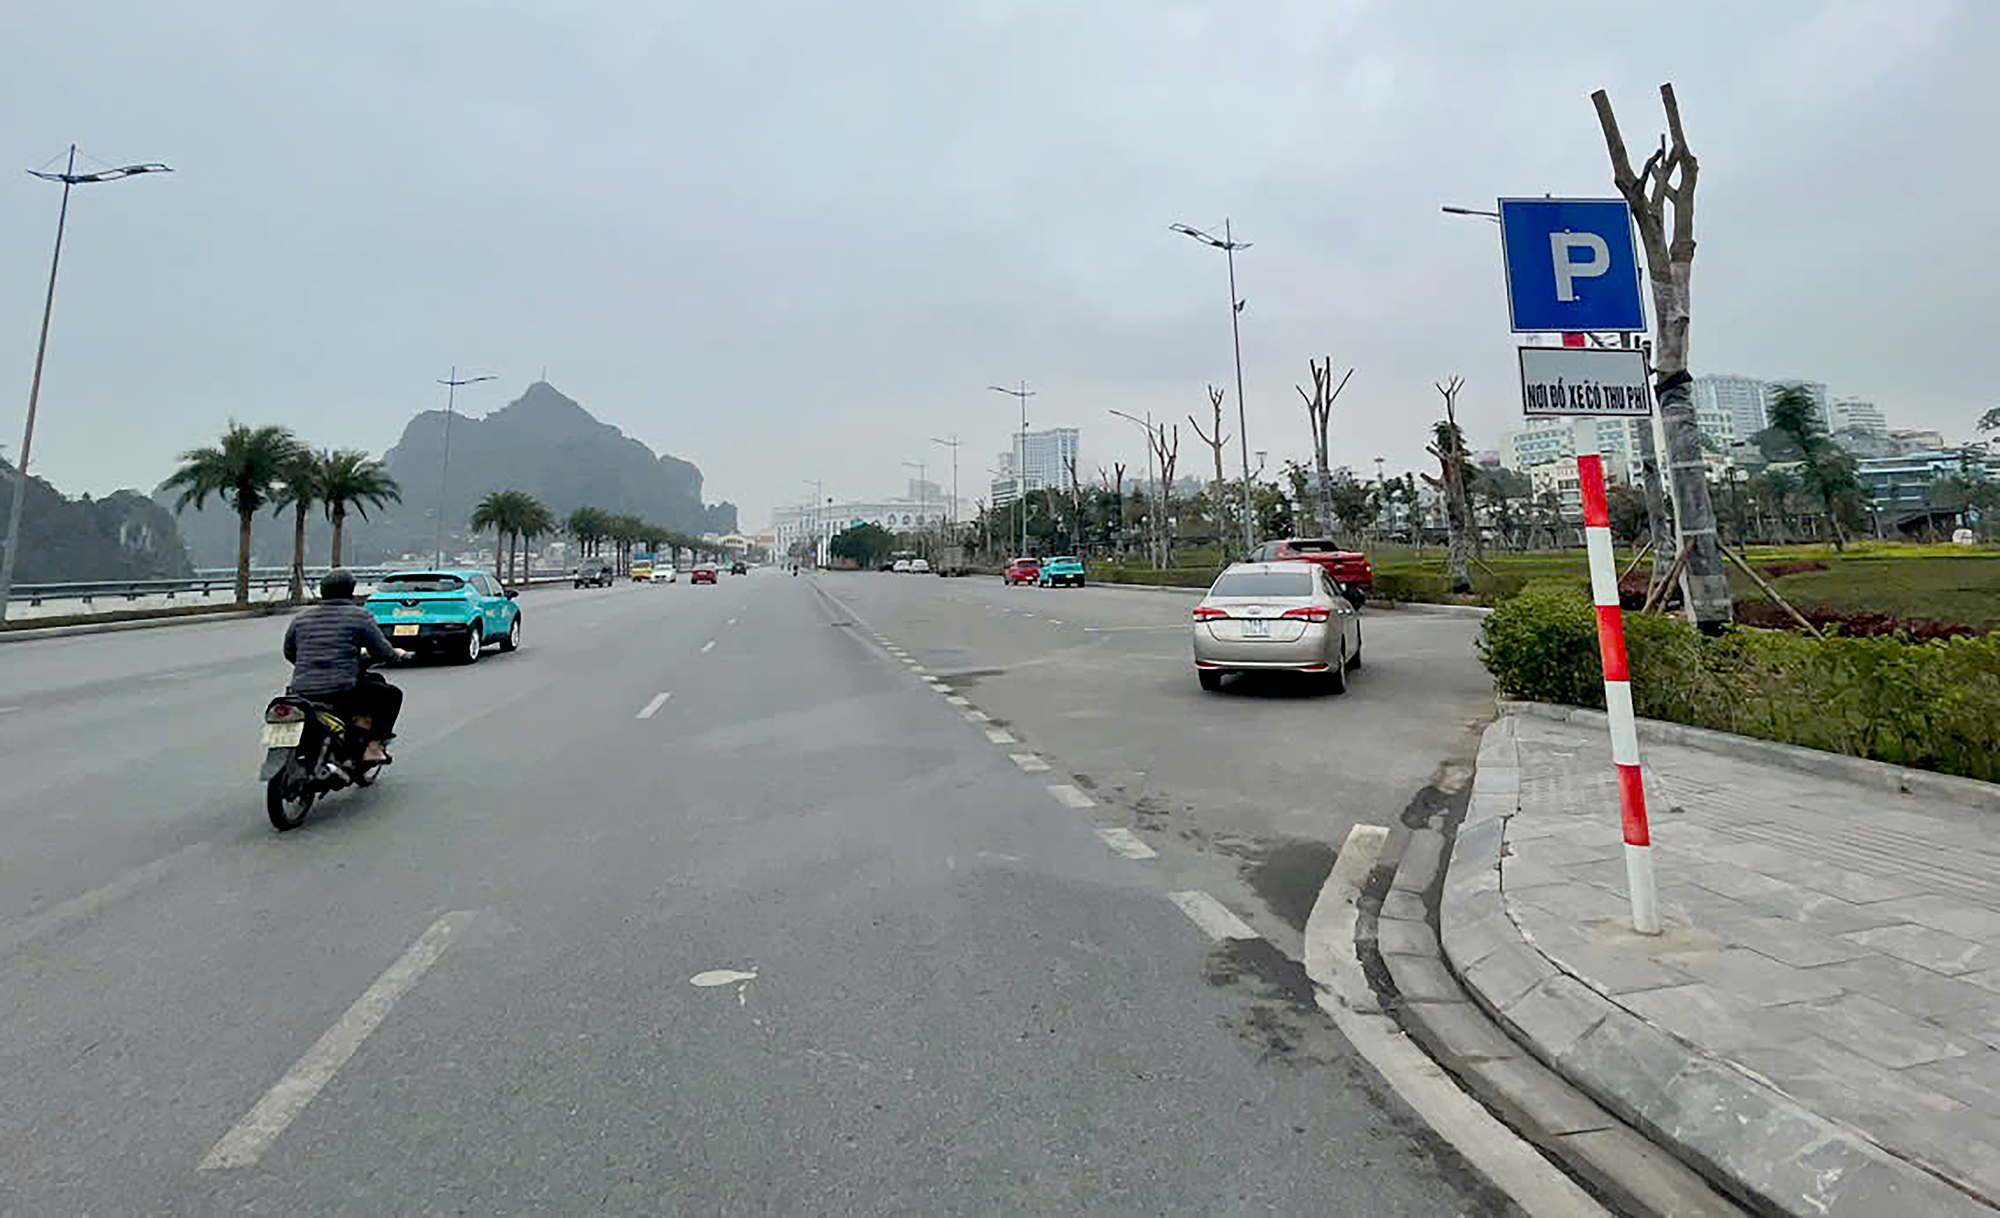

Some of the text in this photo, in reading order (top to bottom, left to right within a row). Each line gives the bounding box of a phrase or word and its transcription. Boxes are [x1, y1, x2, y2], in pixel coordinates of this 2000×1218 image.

[1550, 231, 1611, 302] P
[1568, 384, 1585, 409] XE
[1586, 381, 1602, 409] CÓ
[1603, 386, 1625, 409] THU
[1627, 382, 1647, 409] PHÍ
